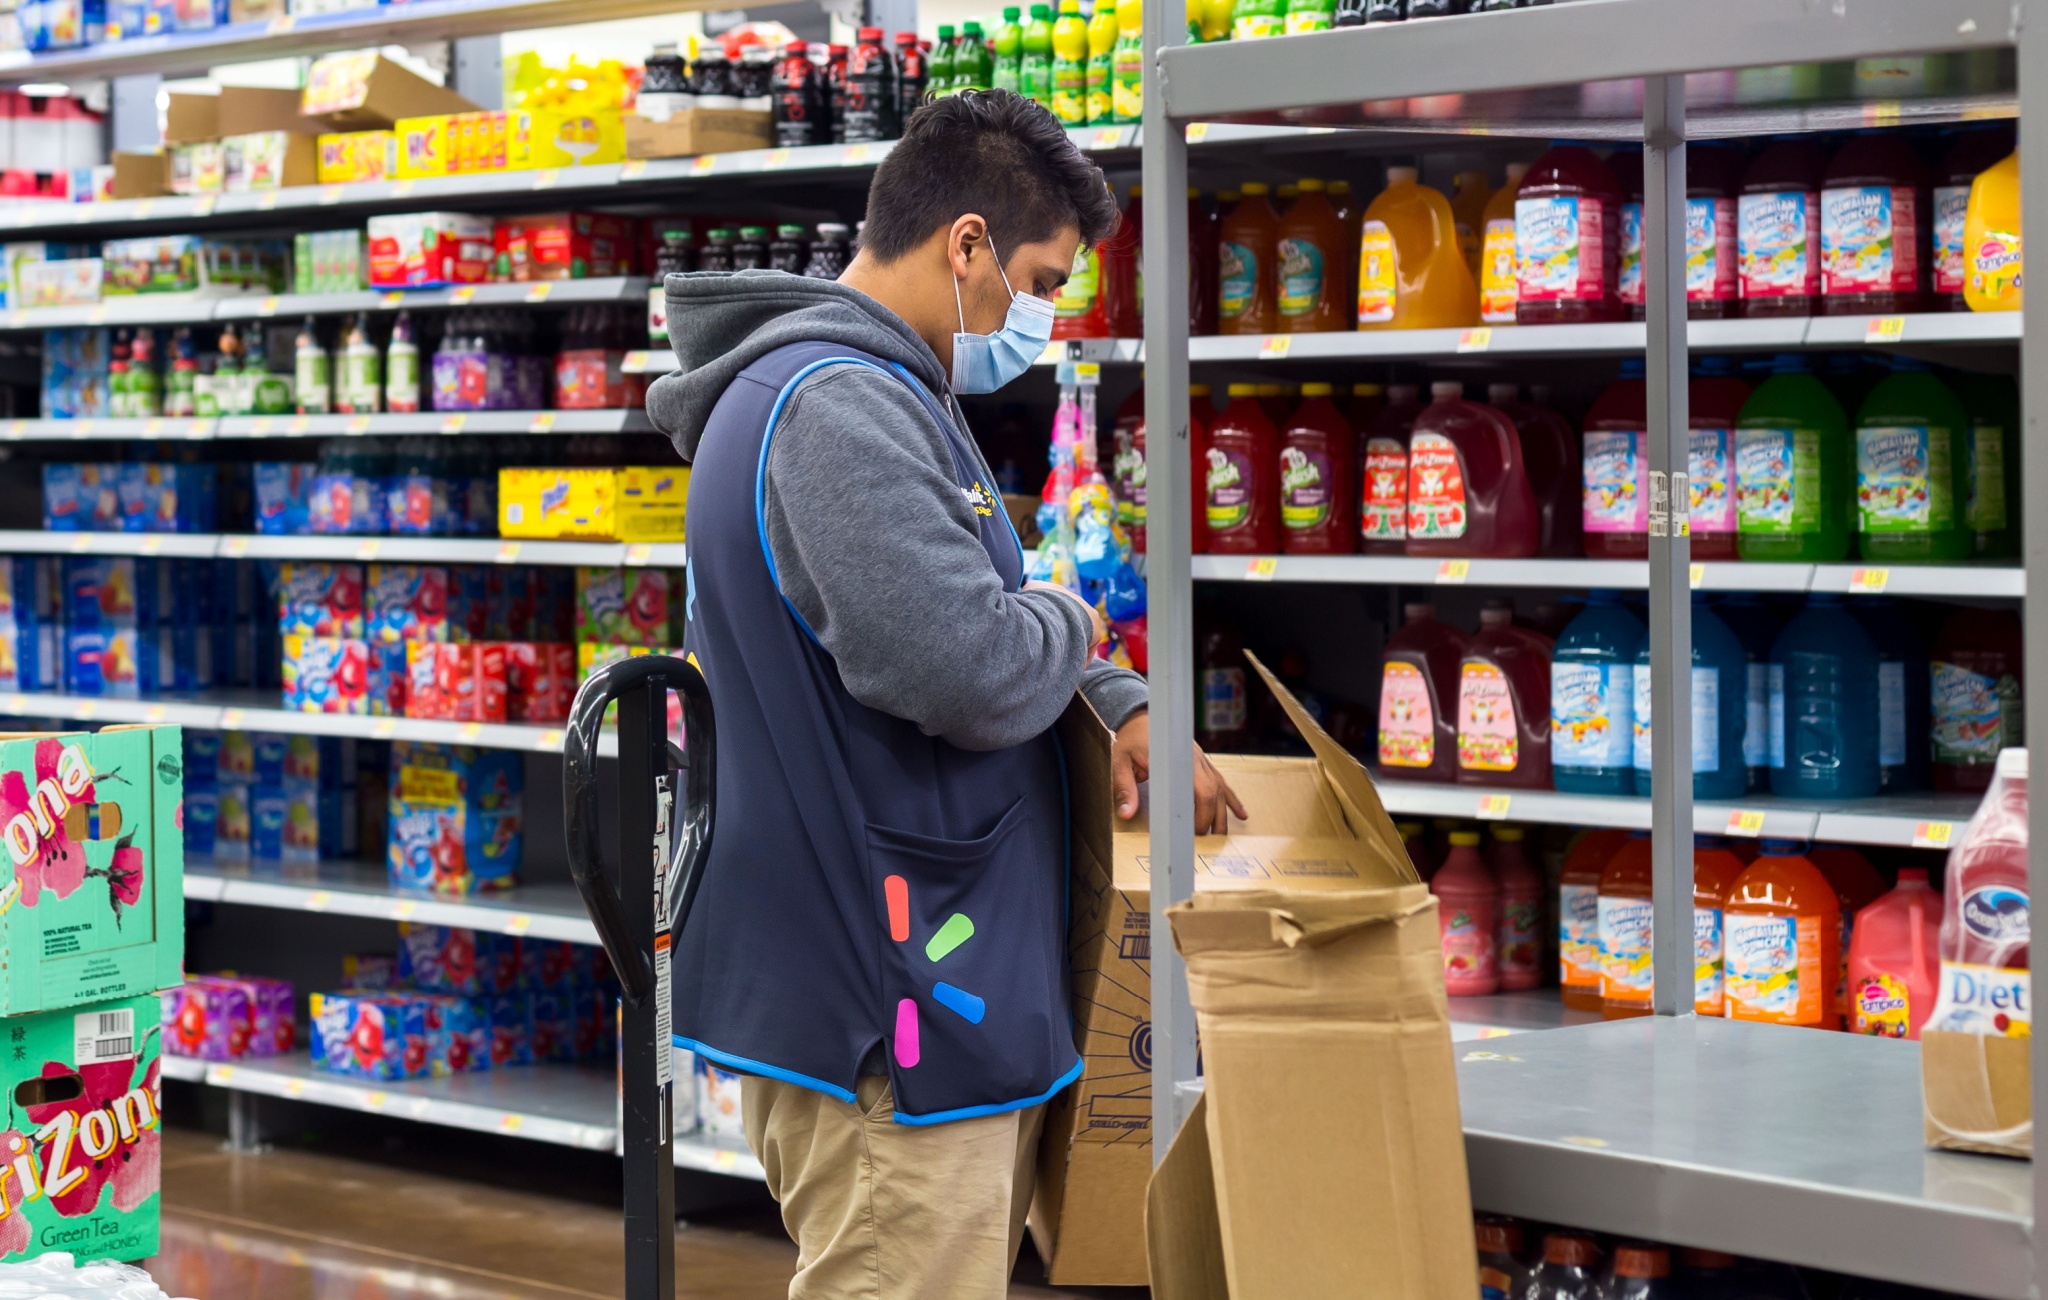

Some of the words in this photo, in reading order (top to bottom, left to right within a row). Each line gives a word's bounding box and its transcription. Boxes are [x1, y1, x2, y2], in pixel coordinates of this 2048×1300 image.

[1734, 922, 1789, 944] HAWAIIAN
[100, 983, 127, 995] BOTTLES
[1952, 972, 2026, 1012] Diet
[41, 1226, 89, 1247] Green
[90, 1217, 119, 1237] Tea
[103, 1234, 141, 1251] HONEY
